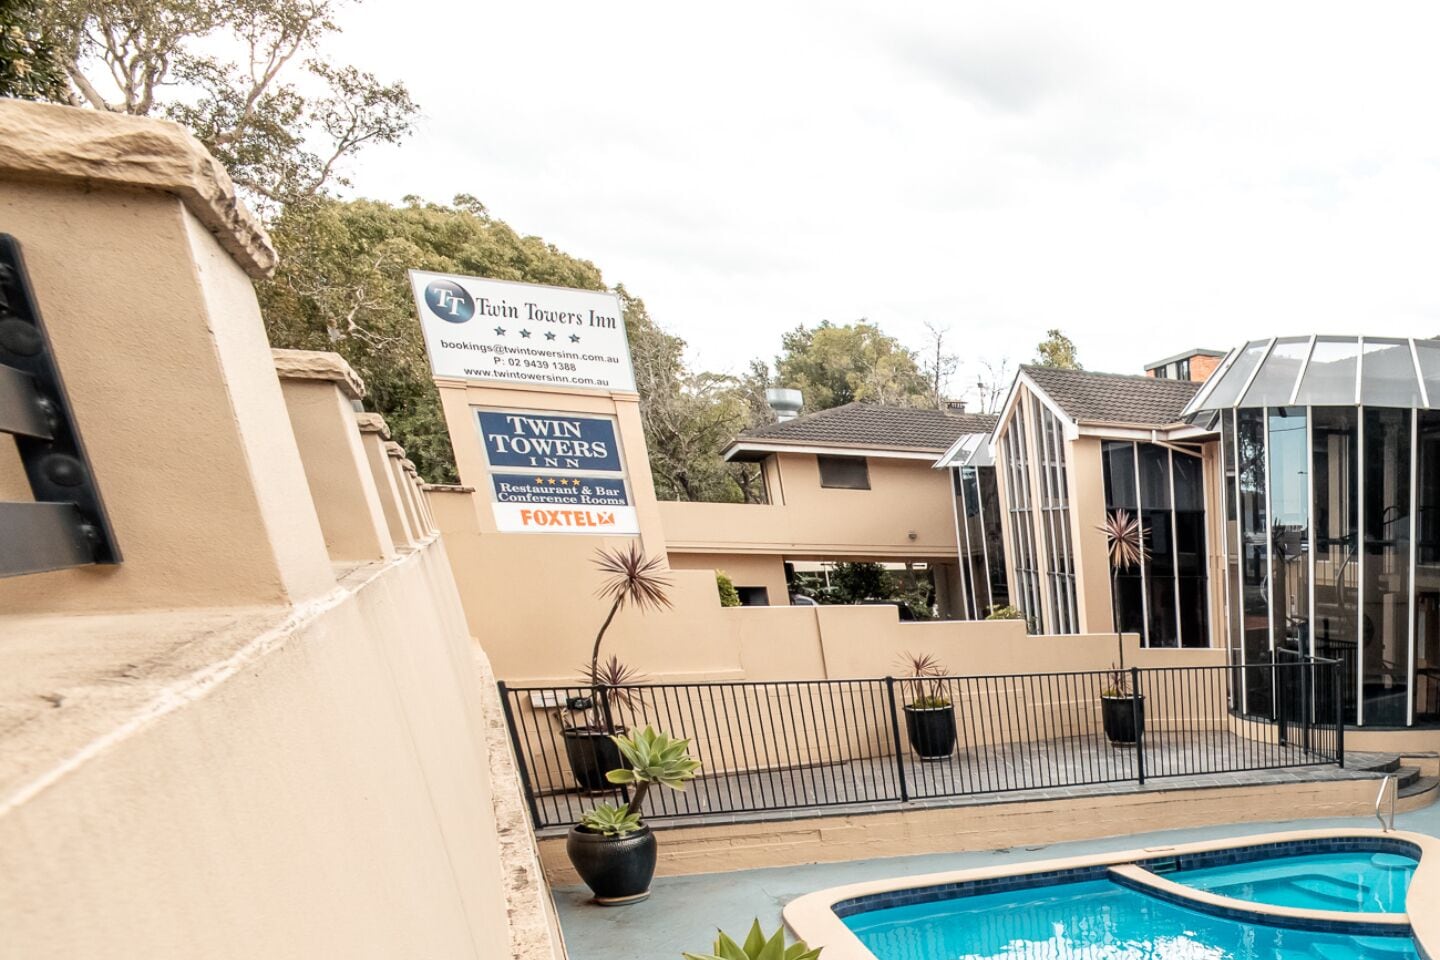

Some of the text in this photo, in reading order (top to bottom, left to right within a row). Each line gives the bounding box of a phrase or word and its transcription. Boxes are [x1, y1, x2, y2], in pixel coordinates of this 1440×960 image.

[433, 288, 465, 316] TT
[476, 297, 617, 329] Twin Towers Inn
[440, 339, 619, 364] bookings@twintowersinn.com.au
[508, 358, 521, 367] 02
[523, 359, 549, 370] 9439
[552, 361, 577, 372] 1388
[463, 368, 610, 387] www.twintowersinn.com.au
[506, 415, 581, 439] TWIN
[488, 434, 608, 459] TOWERS
[498, 492, 626, 506] Conference Rooms
[499, 482, 620, 497] Restaurant & Bar
[520, 508, 597, 527] FOXTEL
